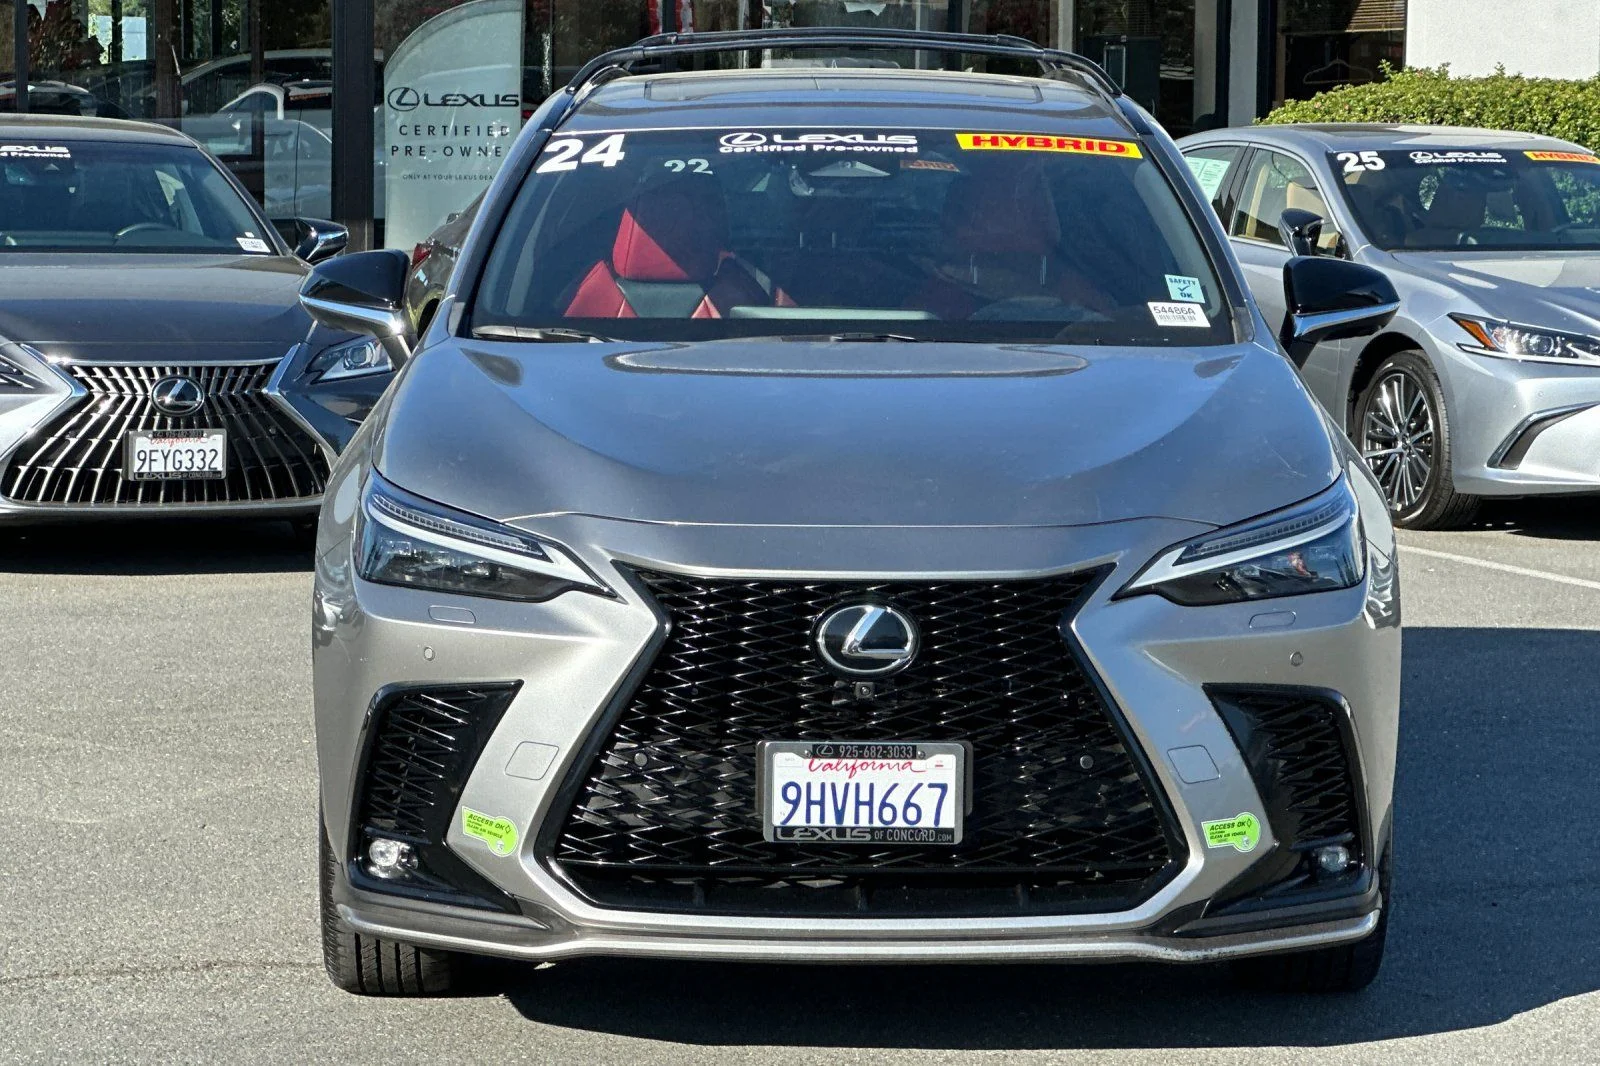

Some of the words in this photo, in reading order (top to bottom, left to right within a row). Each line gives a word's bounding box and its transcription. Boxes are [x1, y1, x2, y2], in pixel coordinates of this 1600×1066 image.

[424, 94, 519, 107] LEXUS
[399, 125, 510, 136] CERTIFIED
[773, 134, 918, 144] LEXUS
[973, 135, 1127, 154] HYBRID
[0, 145, 69, 153] EXUS
[391, 145, 511, 157] PRE-OWNE
[536, 133, 625, 173] 24
[719, 144, 806, 153] Certified
[813, 144, 918, 154] Pre-owned
[1434, 151, 1502, 159] LEXUS
[1337, 151, 1386, 172] 25
[433, 173, 452, 181] YOUR
[455, 173, 477, 181] LEXUS
[479, 173, 496, 181] DEA
[1168, 277, 1196, 286] SAFETY
[1153, 306, 1196, 315] 54486A
[136, 448, 218, 472] 9FYG332
[839, 745, 913, 759] 925-682-3033
[808, 758, 926, 779] California
[780, 781, 949, 827] 9HVH667
[468, 813, 494, 827] ACCESS
[1209, 822, 1235, 832] ACCESS
[776, 827, 871, 841] LEXUS
[874, 829, 884, 840] OF
